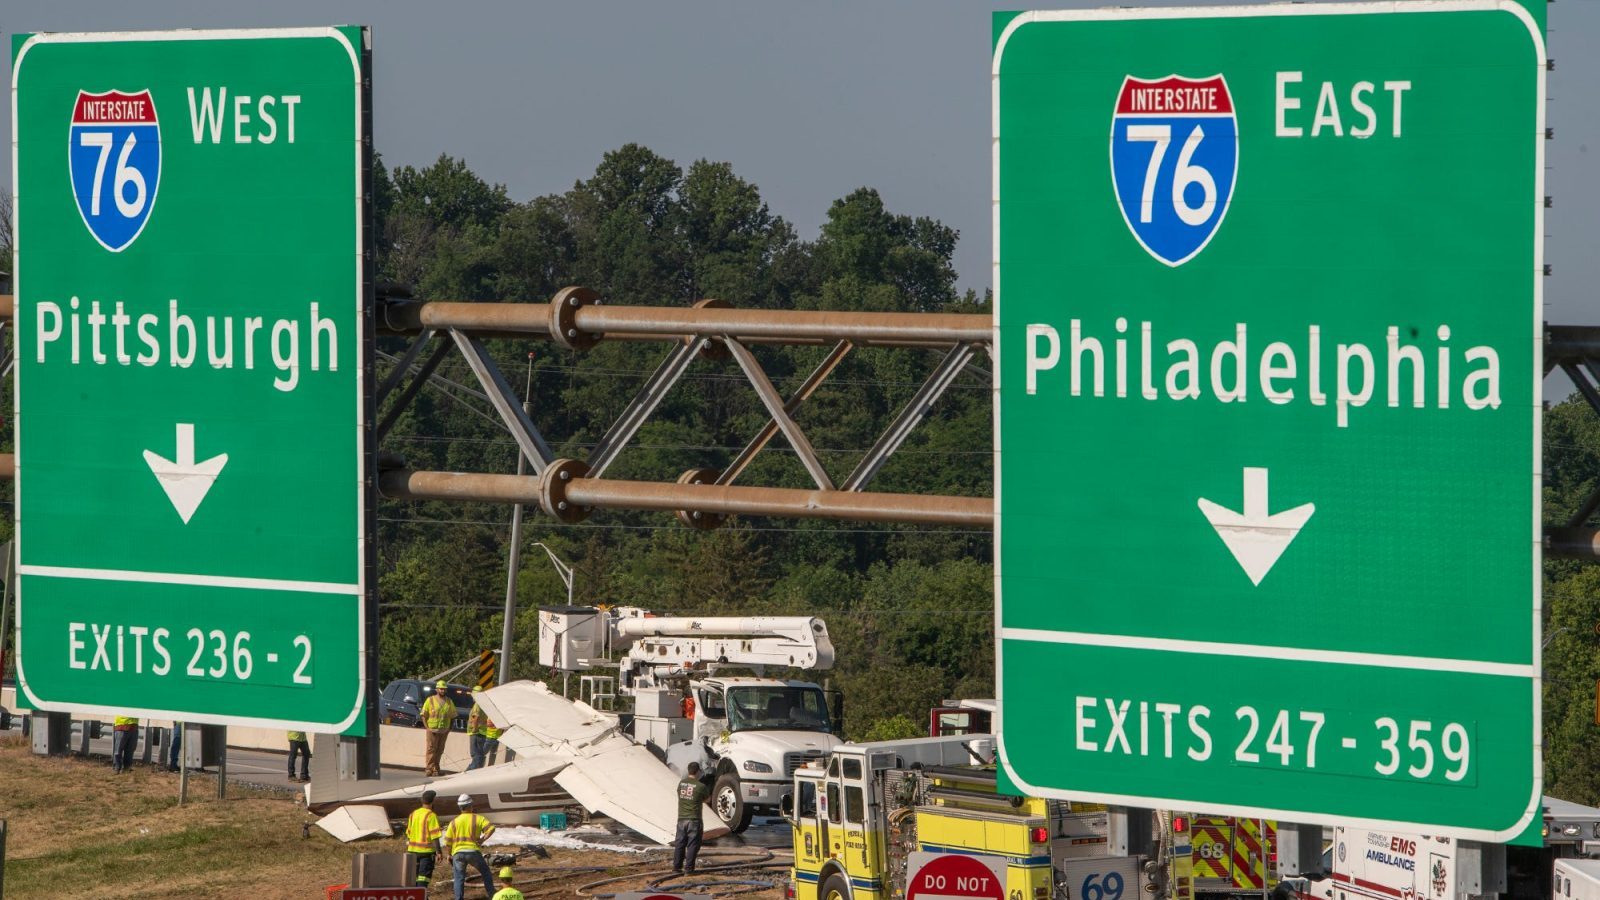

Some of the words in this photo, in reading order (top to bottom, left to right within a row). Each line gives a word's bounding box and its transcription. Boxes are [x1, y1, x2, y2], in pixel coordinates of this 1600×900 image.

[83, 100, 146, 121] INTERSTATE
[187, 86, 301, 144] WEST
[1131, 87, 1217, 111] INTERSTATE
[1275, 71, 1411, 138] EAST
[80, 132, 147, 218] 76
[1126, 124, 1217, 226] 76
[37, 295, 338, 392] Pittsburgh
[1026, 317, 1501, 427] Philadelphia
[69, 622, 171, 676] EXITS
[186, 628, 252, 680] 236
[267, 653, 278, 662] -
[293, 635, 312, 684] 2
[1075, 696, 1213, 761] EXITS
[1235, 706, 1325, 768] 247
[1342, 738, 1357, 749] -
[1374, 717, 1470, 781] 359
[1366, 849, 1415, 871] AMBULANCE
[1390, 836, 1416, 856] EMS
[925, 875, 946, 890] DO
[957, 877, 989, 892] NOT
[1082, 871, 1124, 900] 69
